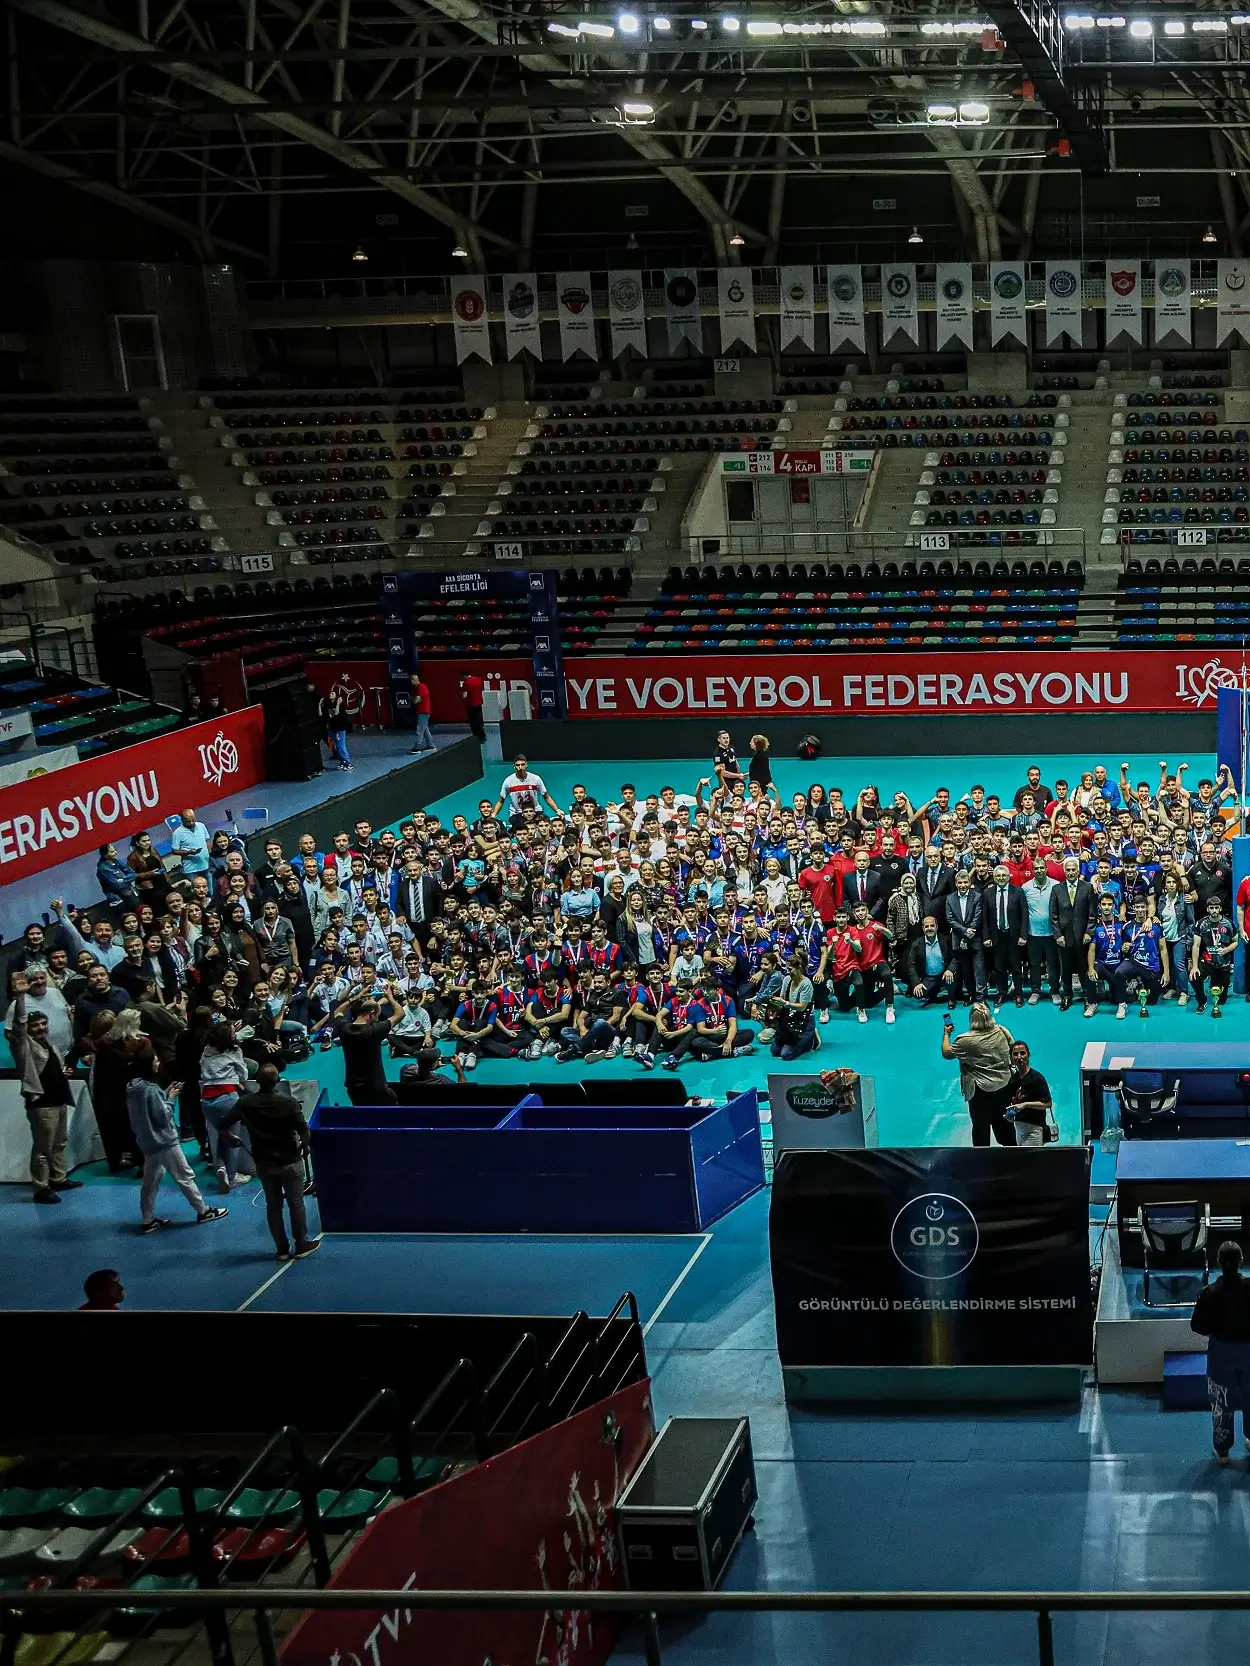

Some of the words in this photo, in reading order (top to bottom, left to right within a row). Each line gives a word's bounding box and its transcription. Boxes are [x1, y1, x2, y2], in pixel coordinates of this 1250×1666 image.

[716, 360, 737, 372] 212
[779, 453, 793, 472] 4
[795, 462, 816, 472] KAPI
[923, 536, 946, 548] 113
[1180, 531, 1203, 544] 112
[497, 545, 520, 557] 114
[245, 557, 270, 571] 115
[440, 583, 471, 593] EFELER
[471, 580, 488, 592] LİGİ
[625, 674, 832, 709] VOLEYBOL
[842, 671, 1129, 707] FEDERASYONU
[910, 1226, 960, 1247] GDS
[798, 1296, 889, 1311] GÖRÜNTÜLÜ
[893, 1296, 1016, 1311] DEĞERLENDİRME
[1019, 1295, 1077, 1310] SİSTEMİ
